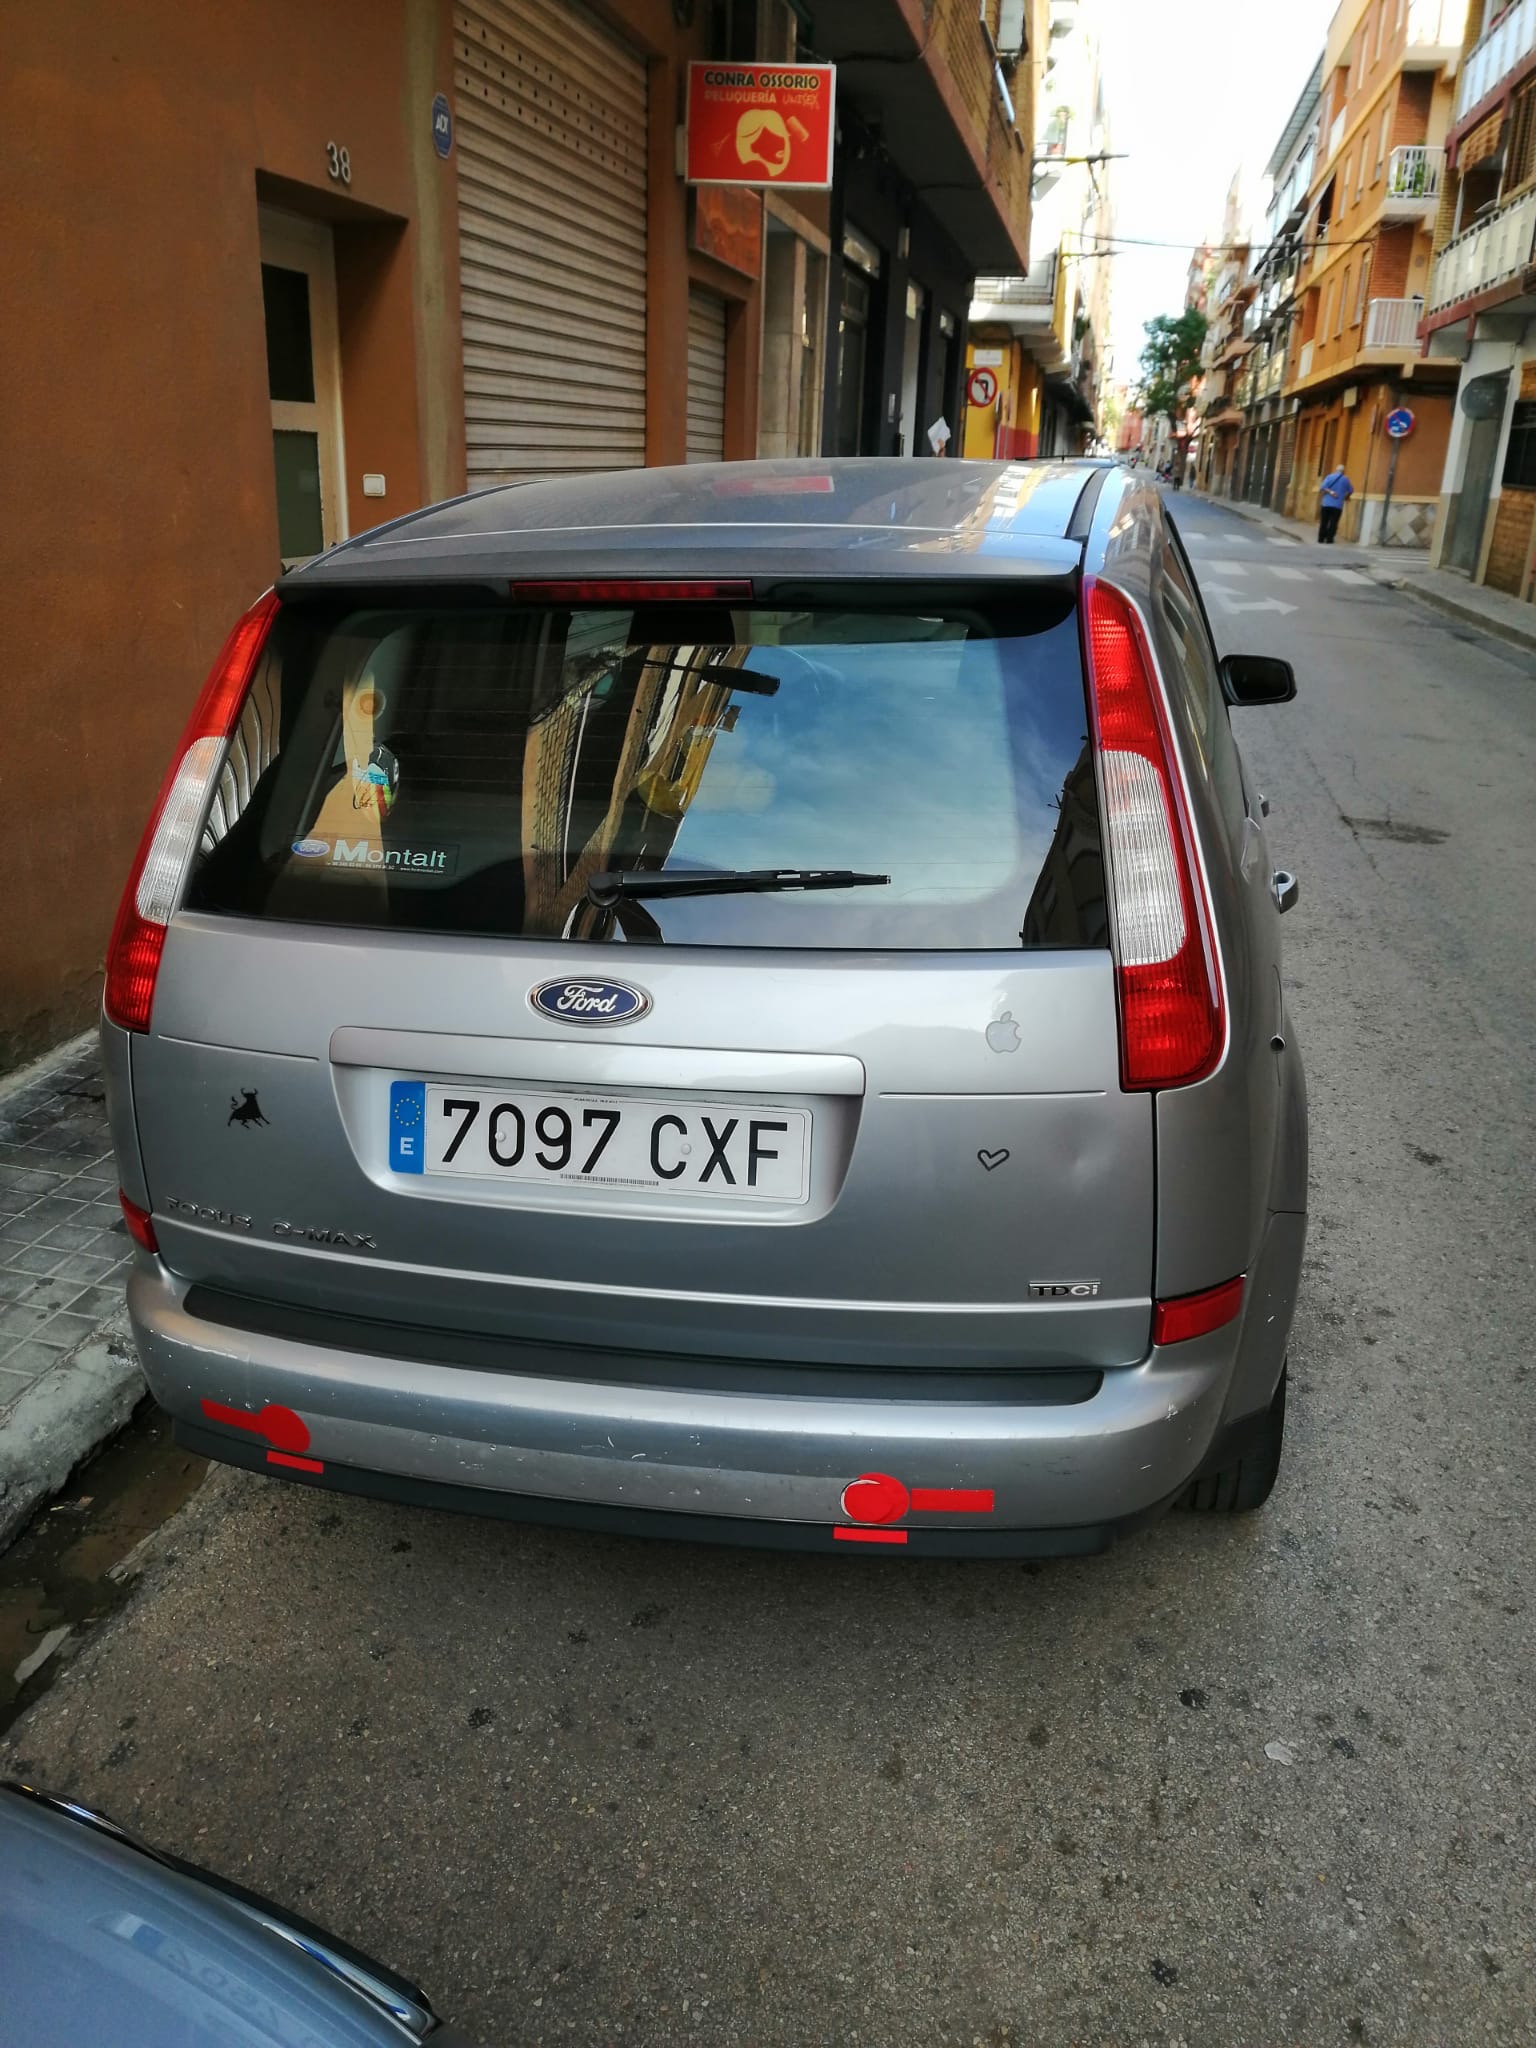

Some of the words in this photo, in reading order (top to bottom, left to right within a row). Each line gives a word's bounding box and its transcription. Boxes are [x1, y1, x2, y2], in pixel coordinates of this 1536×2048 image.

[704, 71, 755, 87] CONRA
[759, 73, 820, 90] OSSORIO
[704, 90, 776, 103] PELUQUERÍA
[327, 141, 351, 183] 38
[333, 839, 447, 868] Montalt
[557, 984, 618, 1013] Ford
[400, 1137, 414, 1155] E
[442, 1098, 621, 1174] 7097
[650, 1114, 788, 1186] CXF
[166, 1195, 252, 1229] FOCUS
[272, 1219, 377, 1250] C-MAX
[1032, 1284, 1098, 1296] TDCi
